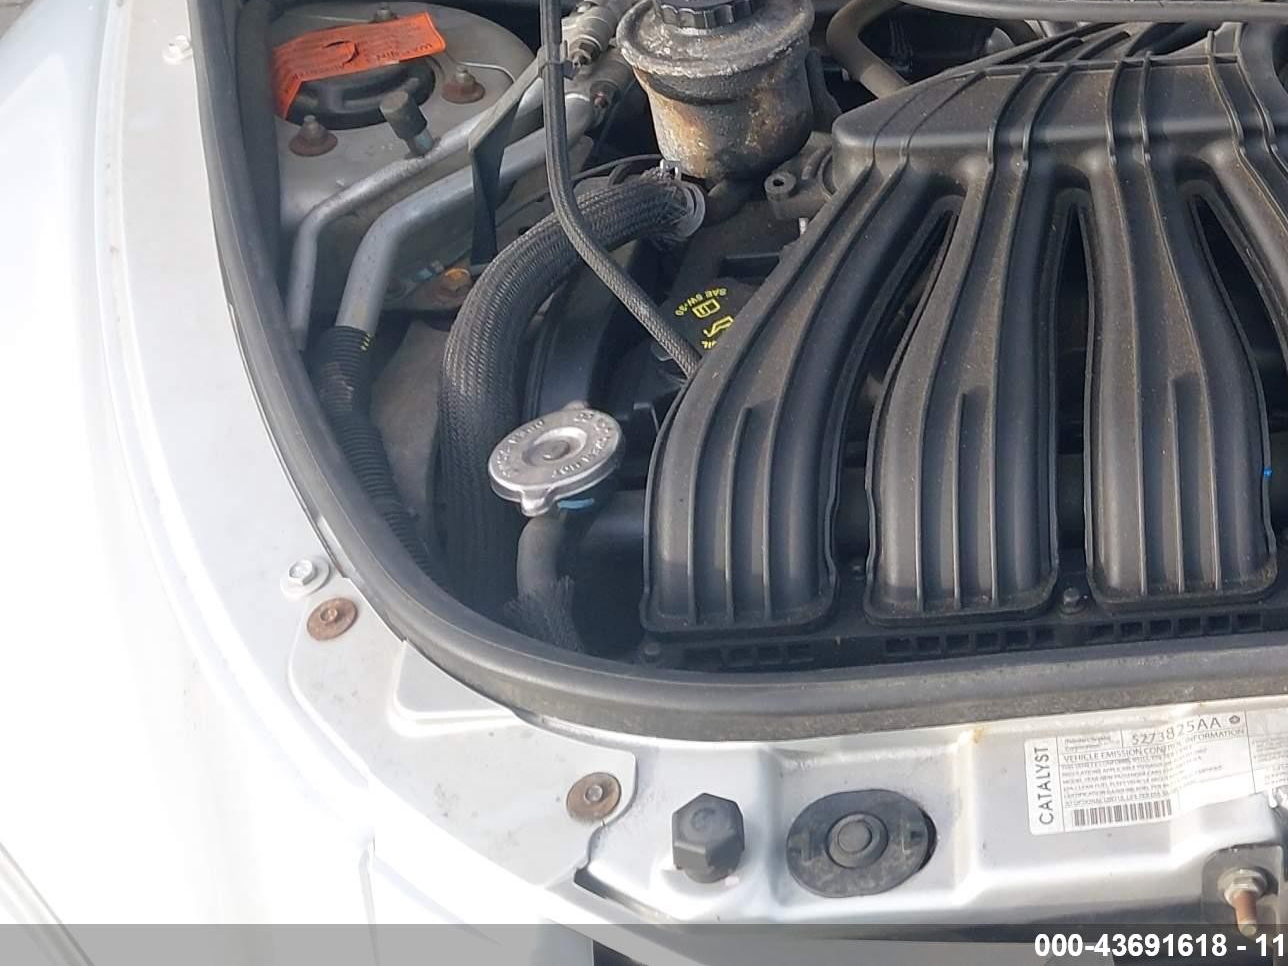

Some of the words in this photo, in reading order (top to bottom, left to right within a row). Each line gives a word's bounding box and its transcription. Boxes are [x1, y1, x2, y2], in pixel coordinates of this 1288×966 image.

[705, 288, 728, 298] SAE
[1064, 751, 1099, 763] VEHICLE
[1100, 746, 1142, 759] EMISSION
[1034, 746, 1055, 826] CATALYST
